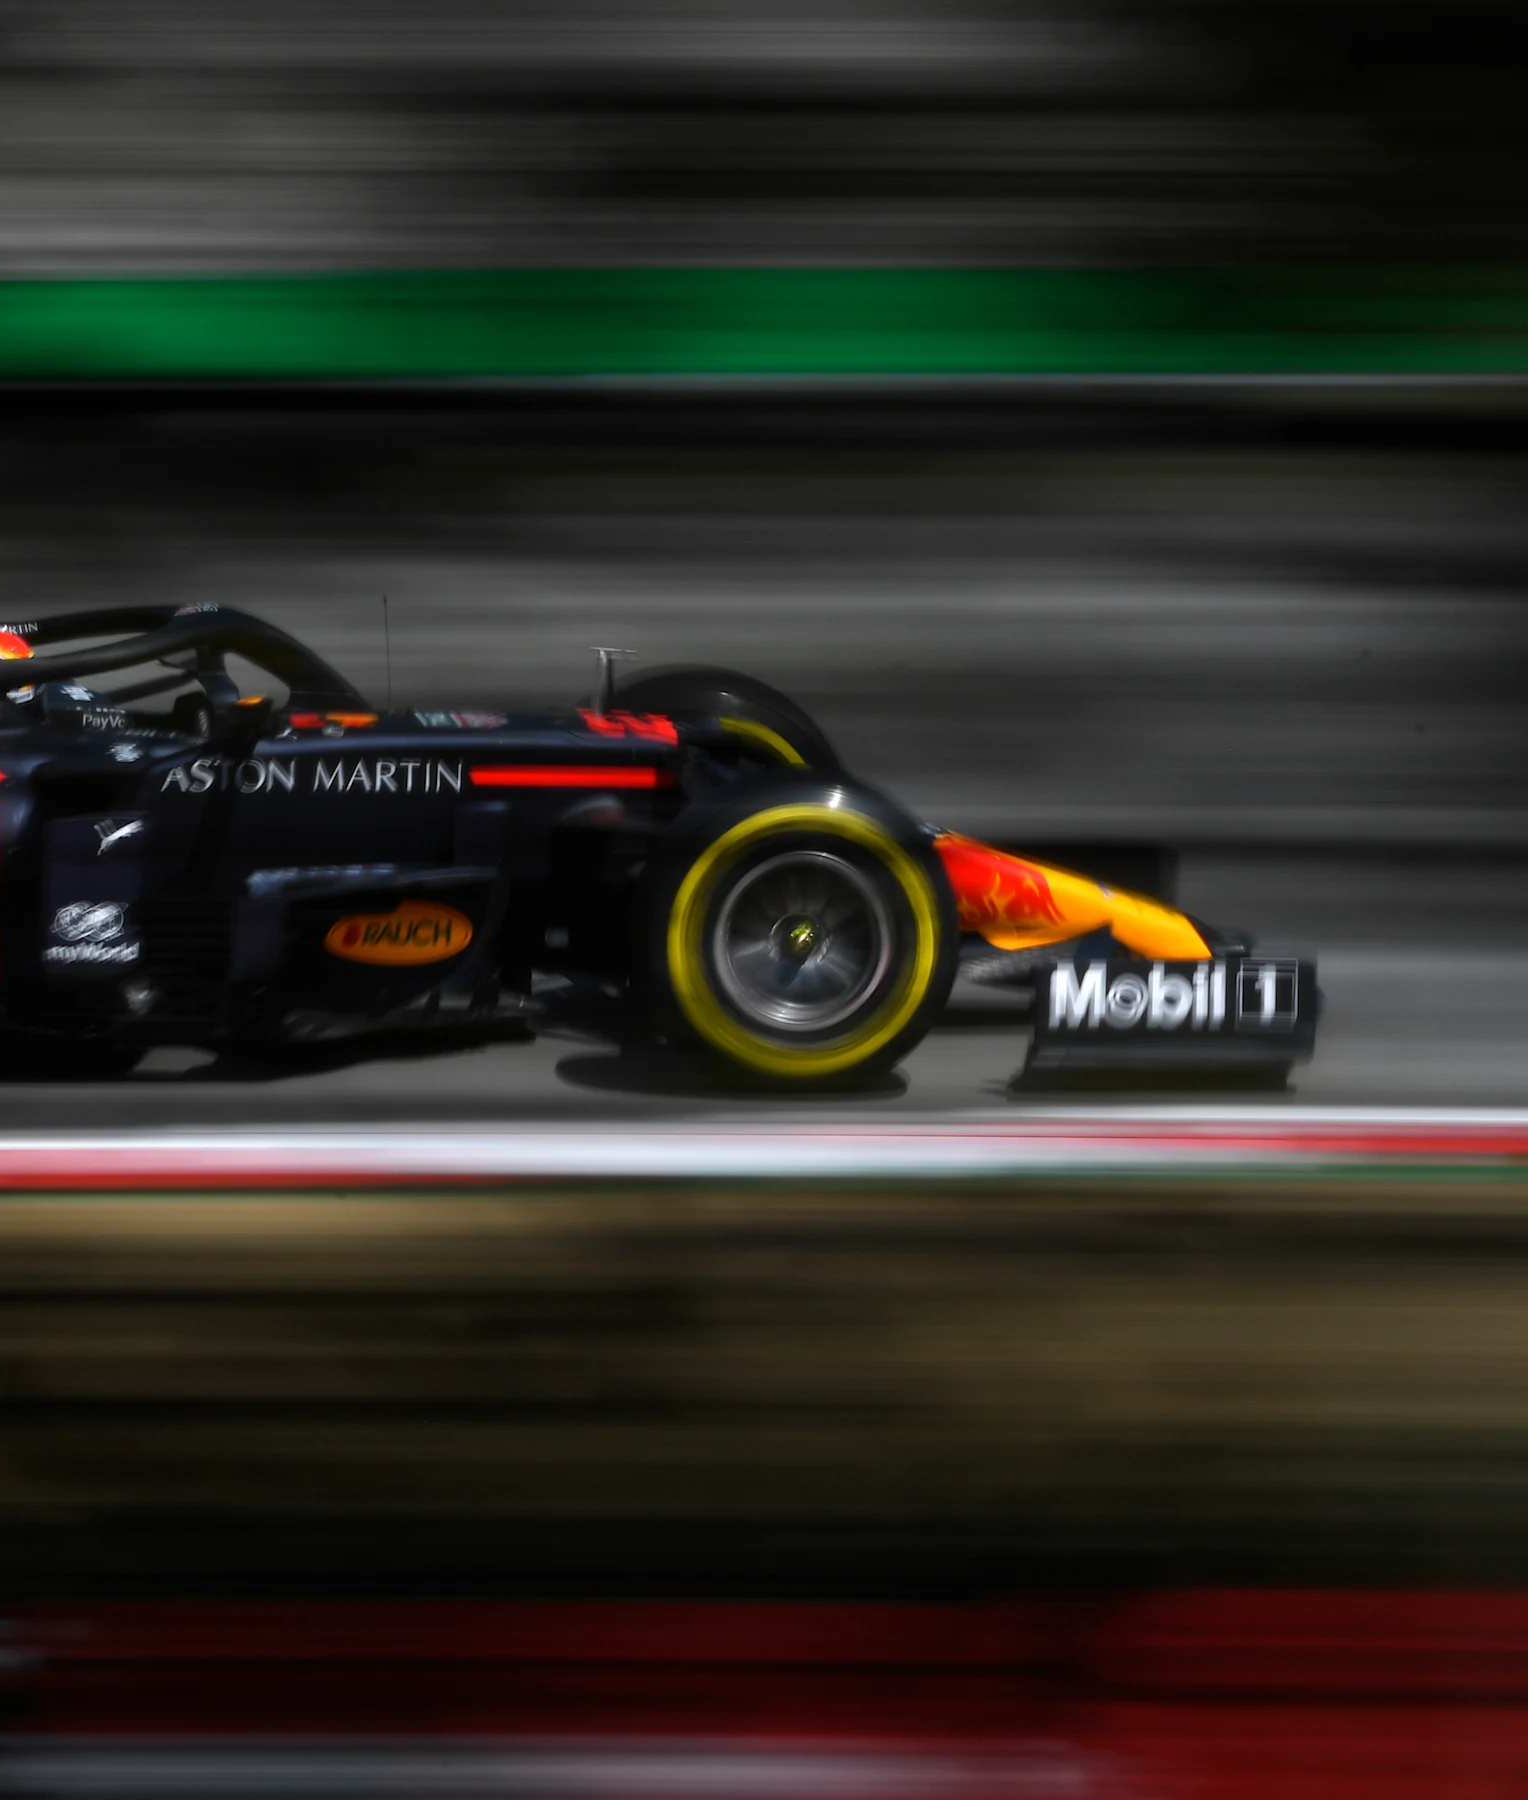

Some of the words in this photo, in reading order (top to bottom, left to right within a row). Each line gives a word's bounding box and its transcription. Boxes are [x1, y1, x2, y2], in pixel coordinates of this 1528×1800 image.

[160, 757, 296, 794] ASTON
[312, 757, 462, 794] MARTIN
[361, 917, 453, 948] RAUCH
[1049, 958, 1226, 1030] Mobil
